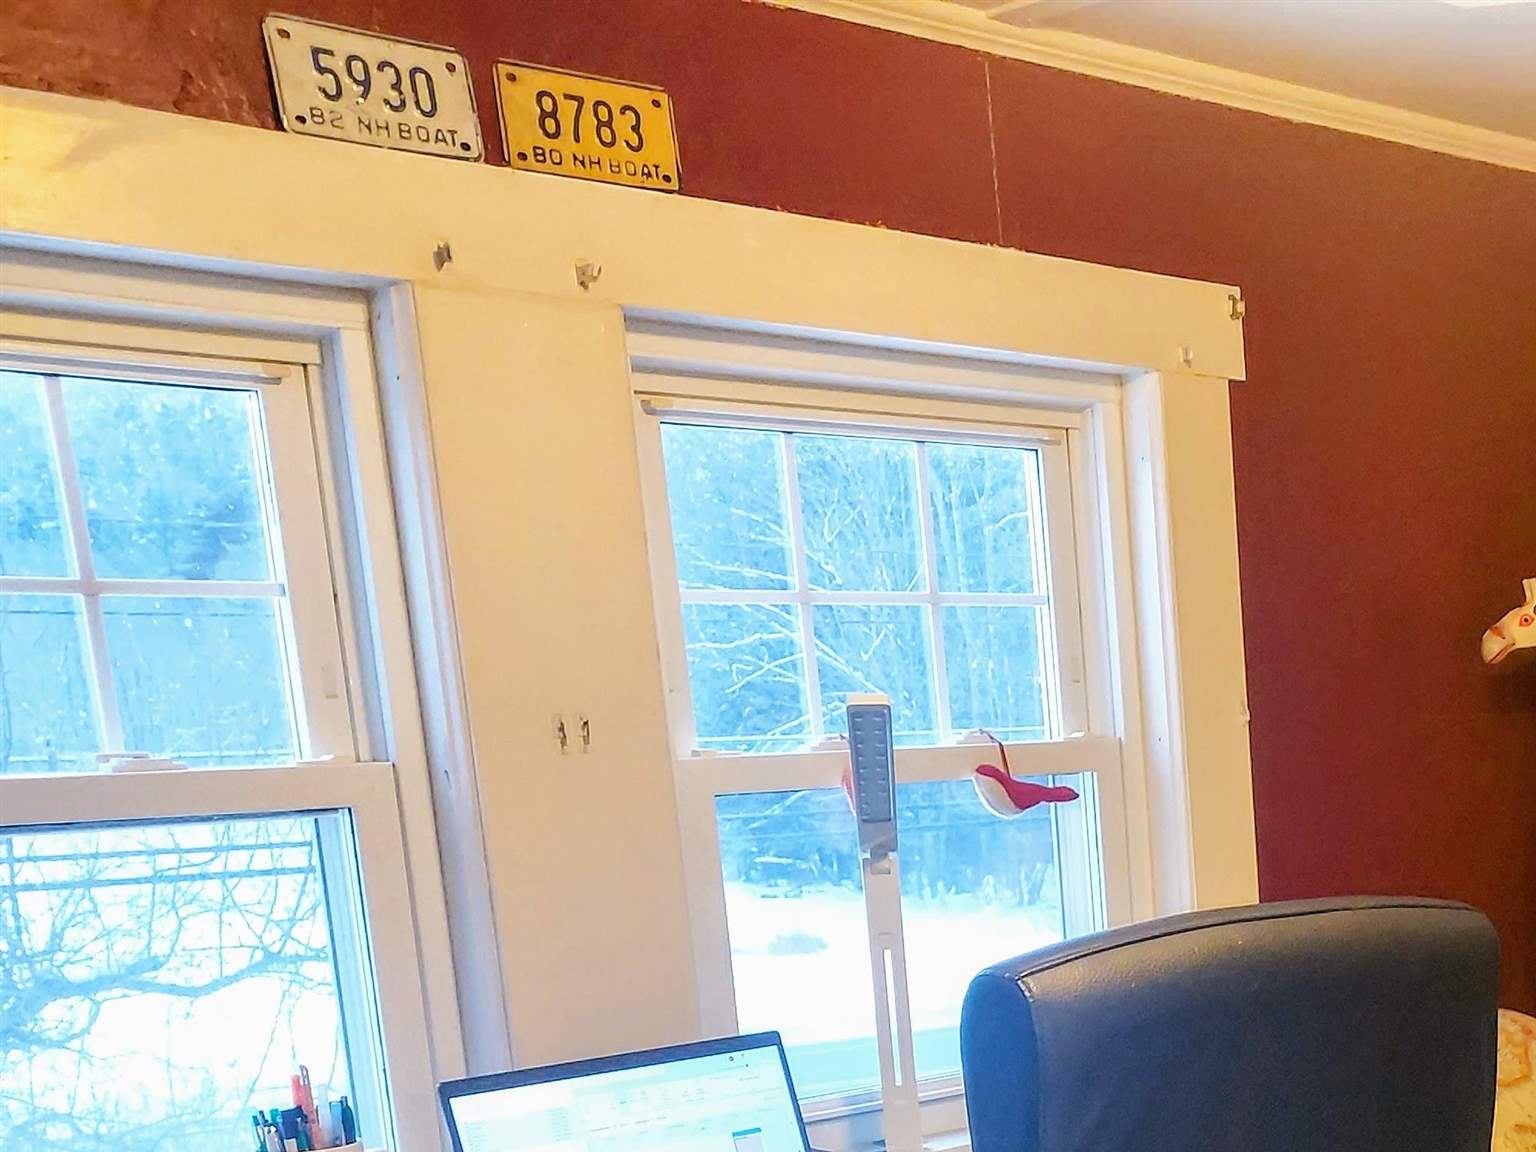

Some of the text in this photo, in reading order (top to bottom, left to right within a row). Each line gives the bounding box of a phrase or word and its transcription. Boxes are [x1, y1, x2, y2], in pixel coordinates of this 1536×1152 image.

[310, 45, 438, 118] 5930
[357, 116, 391, 139] NH
[398, 122, 458, 148] BOAT
[536, 90, 644, 153] 8783
[572, 153, 602, 172] NH
[608, 158, 661, 182] BOAT
